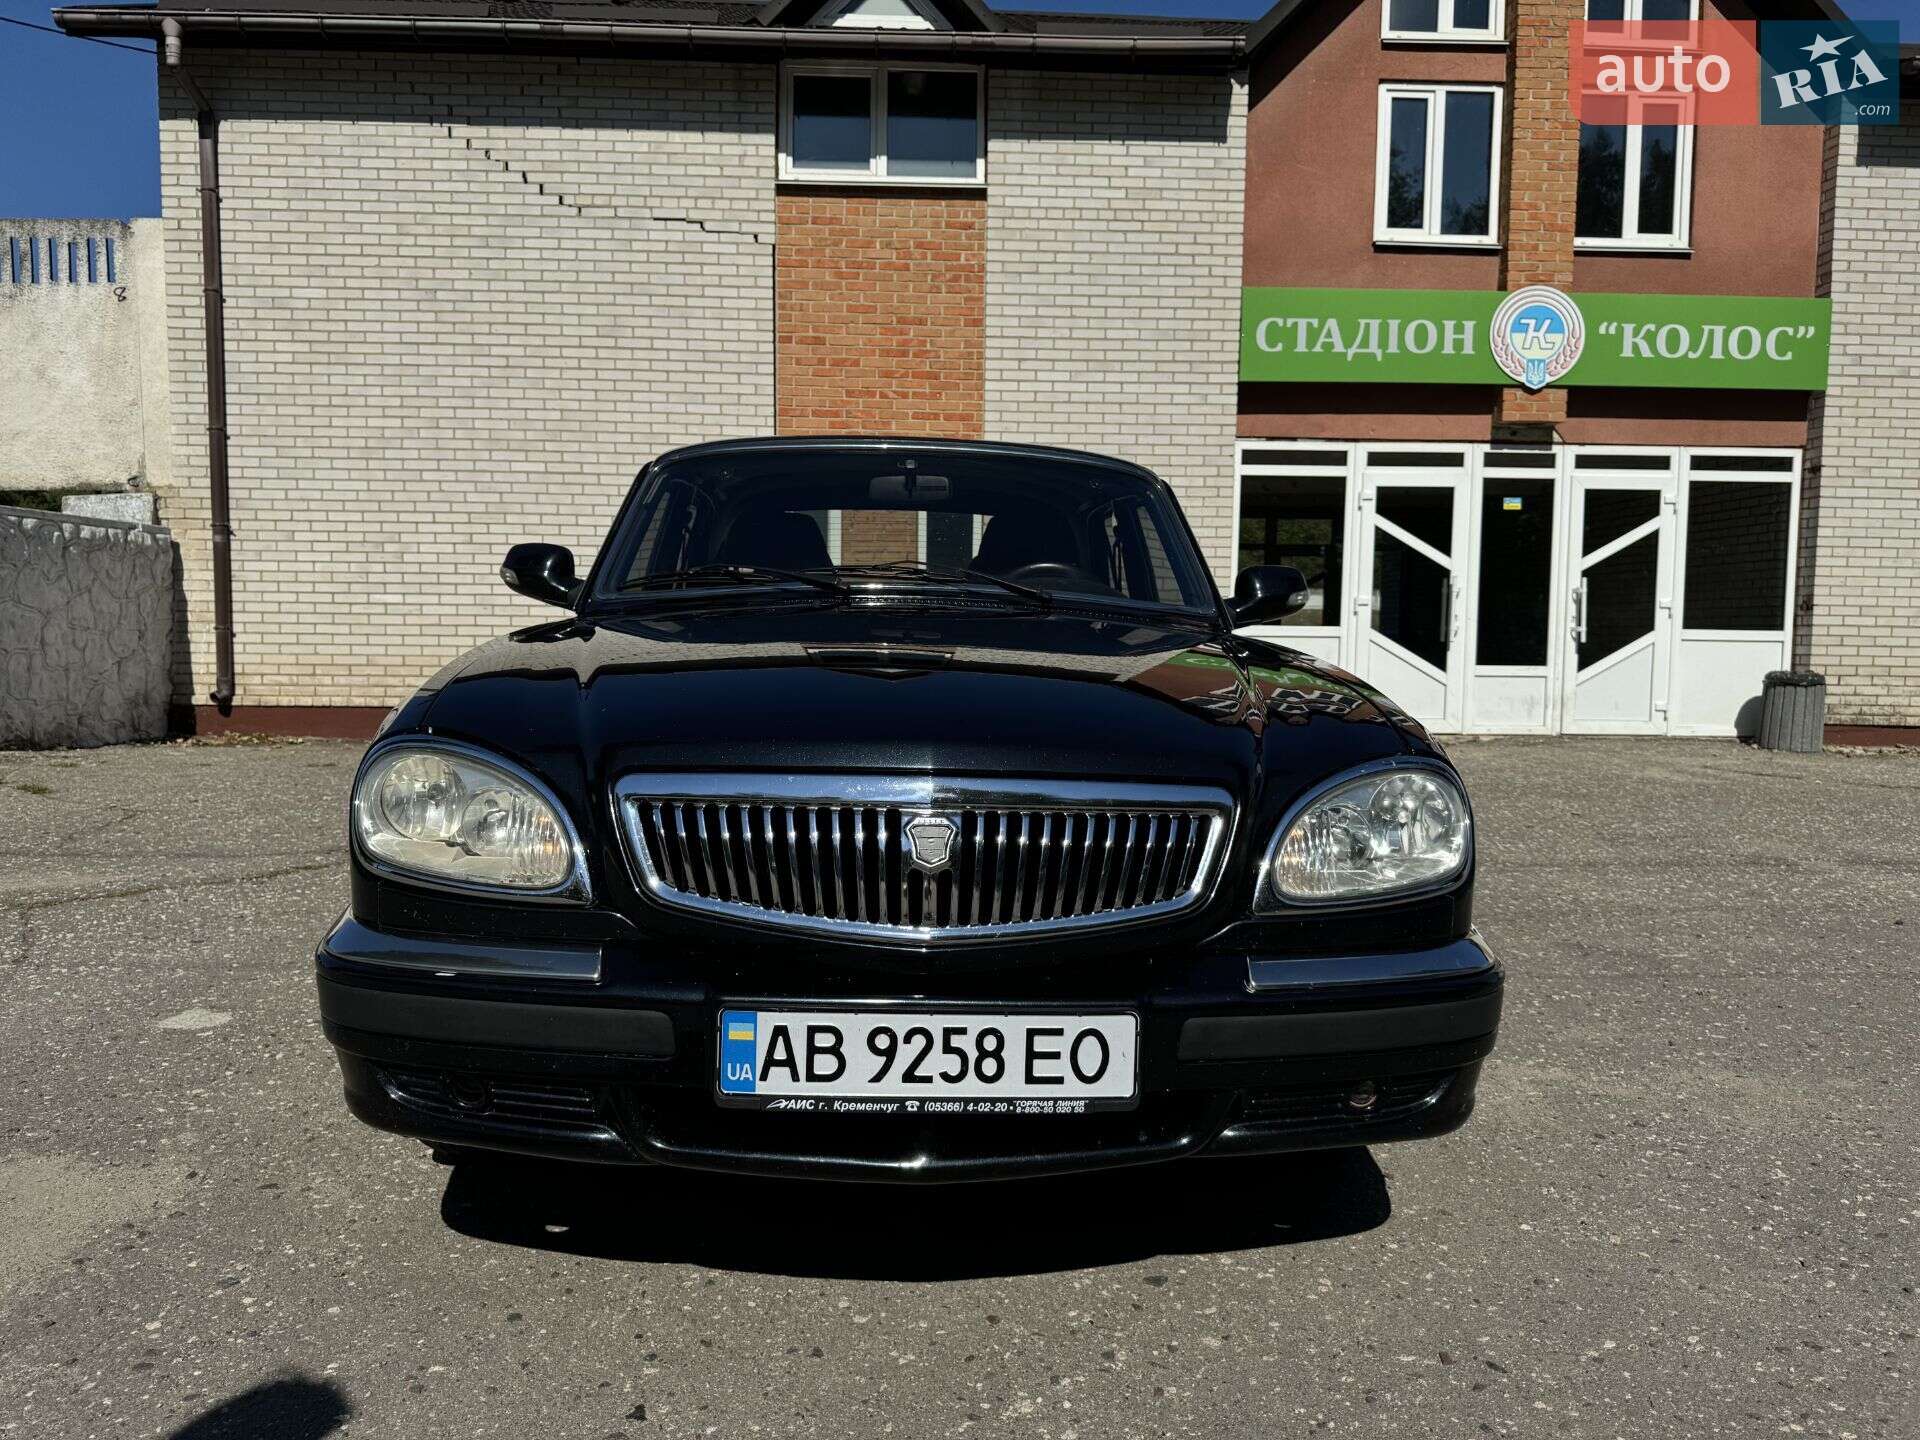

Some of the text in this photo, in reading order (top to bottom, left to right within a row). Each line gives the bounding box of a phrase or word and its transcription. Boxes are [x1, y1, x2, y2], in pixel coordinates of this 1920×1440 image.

[1255, 316, 1477, 362] СТАДІОН
[759, 1024, 1110, 1085] AB 9258 EO
[727, 1062, 753, 1081] UA
[786, 1099, 815, 1110] АИС
[833, 1100, 900, 1113] Кременчуг
[924, 1101, 963, 1112] (05366)
[967, 1102, 1008, 1112] 4-02-20
